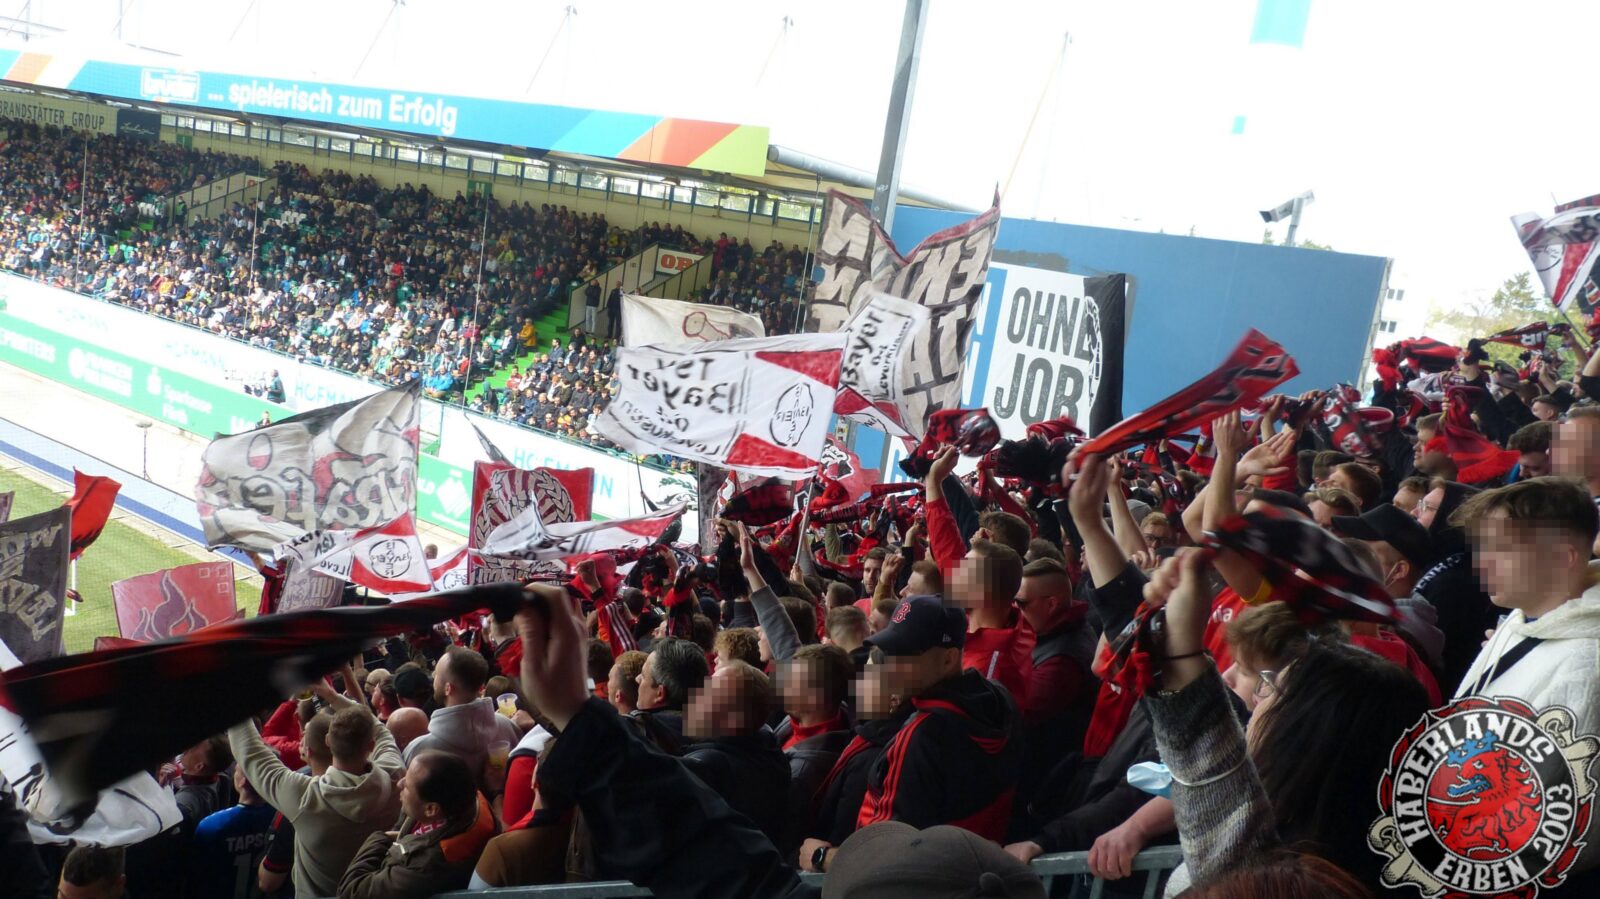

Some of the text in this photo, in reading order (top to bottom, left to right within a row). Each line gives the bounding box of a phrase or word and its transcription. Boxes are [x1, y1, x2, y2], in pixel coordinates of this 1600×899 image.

[71, 111, 105, 131] GROUP
[228, 80, 332, 113] spielerisch
[337, 95, 381, 120] zum
[388, 94, 458, 136] Erfolg
[994, 353, 1084, 428] JOB
